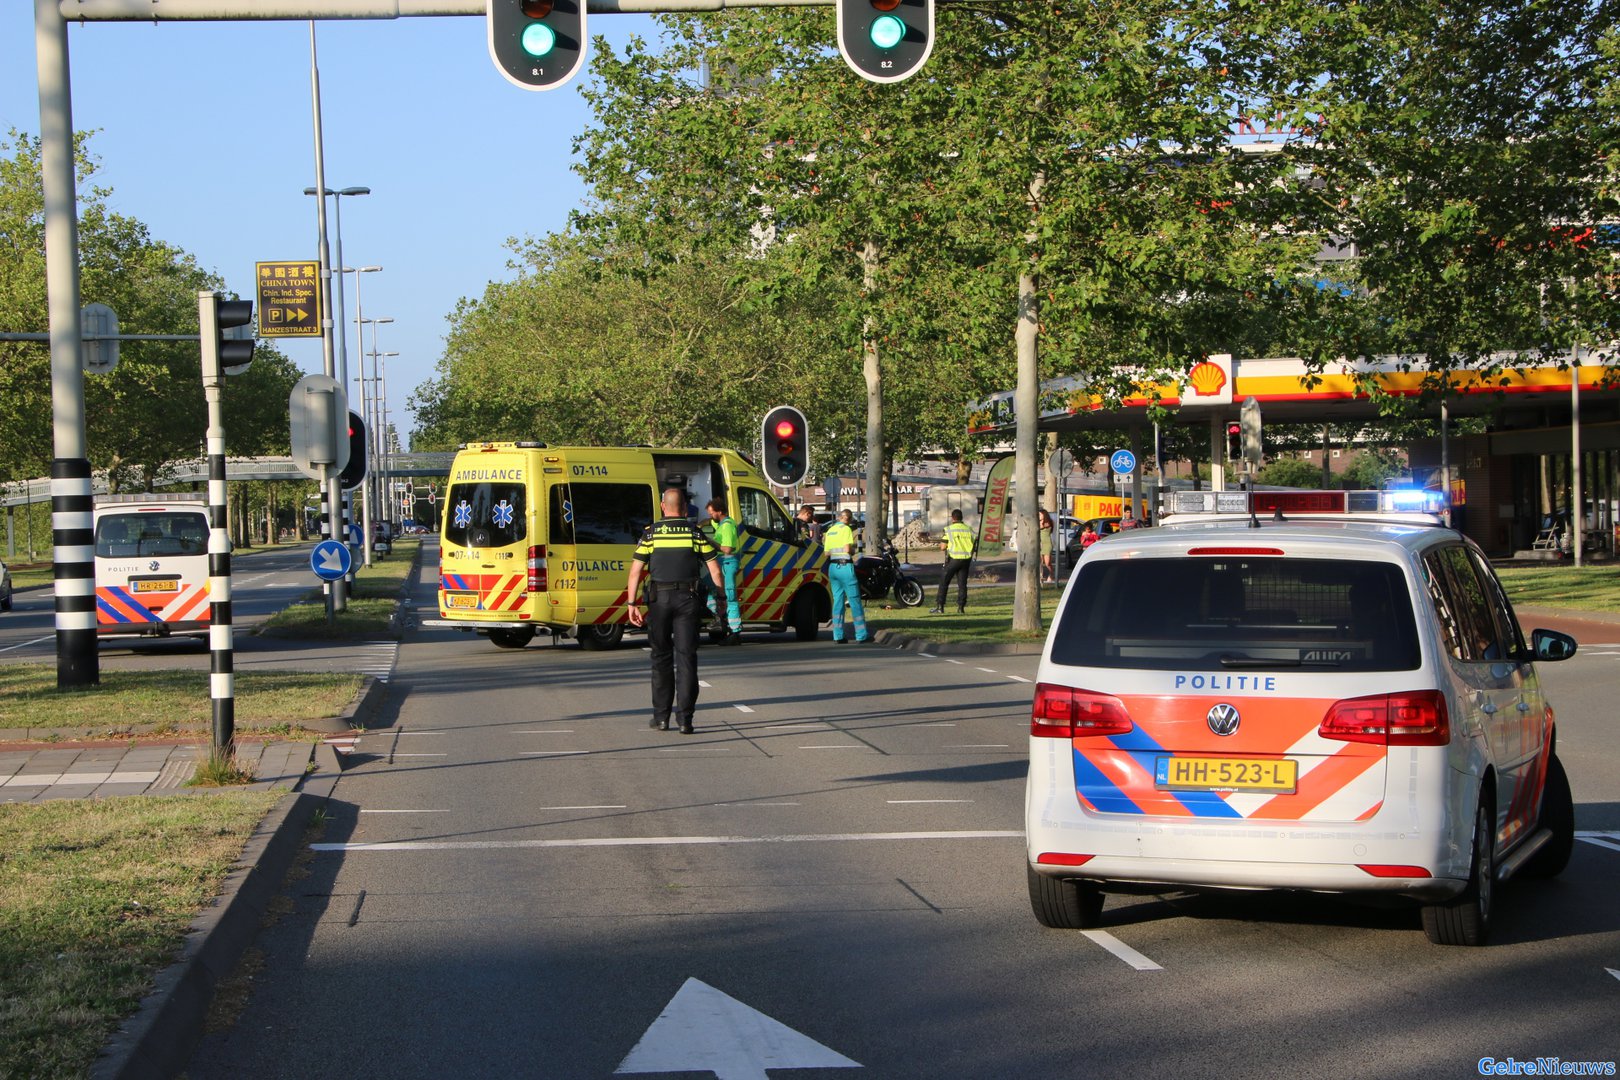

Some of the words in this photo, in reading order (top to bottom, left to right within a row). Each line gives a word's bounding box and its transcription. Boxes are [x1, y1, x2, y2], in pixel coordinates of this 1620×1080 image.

[261, 279, 288, 287] CHINA
[289, 279, 315, 287] TOWN
[263, 289, 280, 297] Chin.
[281, 289, 294, 297] Ind.
[295, 288, 314, 297] Spec.
[271, 310, 280, 321] P
[456, 469, 522, 480] AMBULANCE
[572, 465, 608, 476] 07-114
[989, 477, 1009, 505] BAK
[983, 516, 1001, 542] PAK
[1175, 675, 1275, 691] POLITIE
[1175, 761, 1285, 785] HH-523-L
